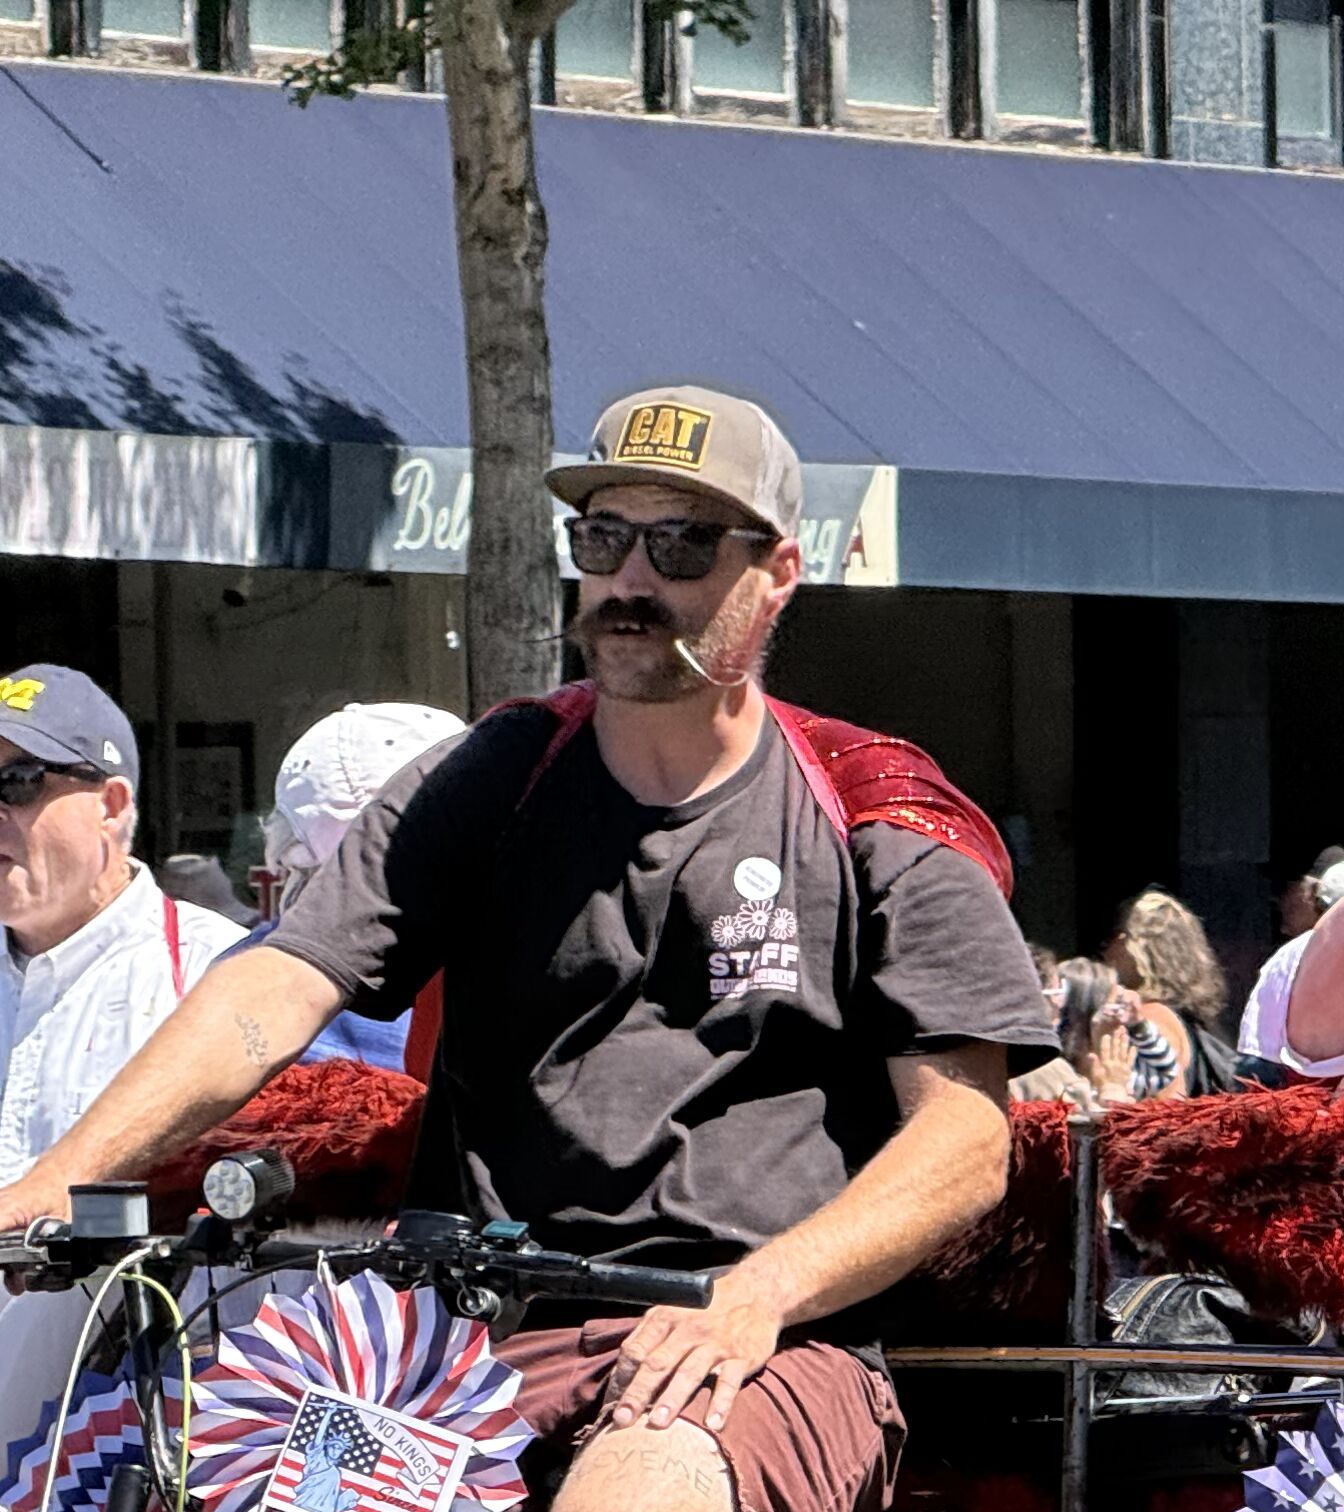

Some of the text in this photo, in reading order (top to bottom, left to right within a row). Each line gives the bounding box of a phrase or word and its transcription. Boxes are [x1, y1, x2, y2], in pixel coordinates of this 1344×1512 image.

[628, 408, 702, 448] CAT
[623, 445, 694, 461] DIESEL POWER
[374, 1416, 432, 1478] NO KINGS
[372, 1485, 419, 1512] Since
